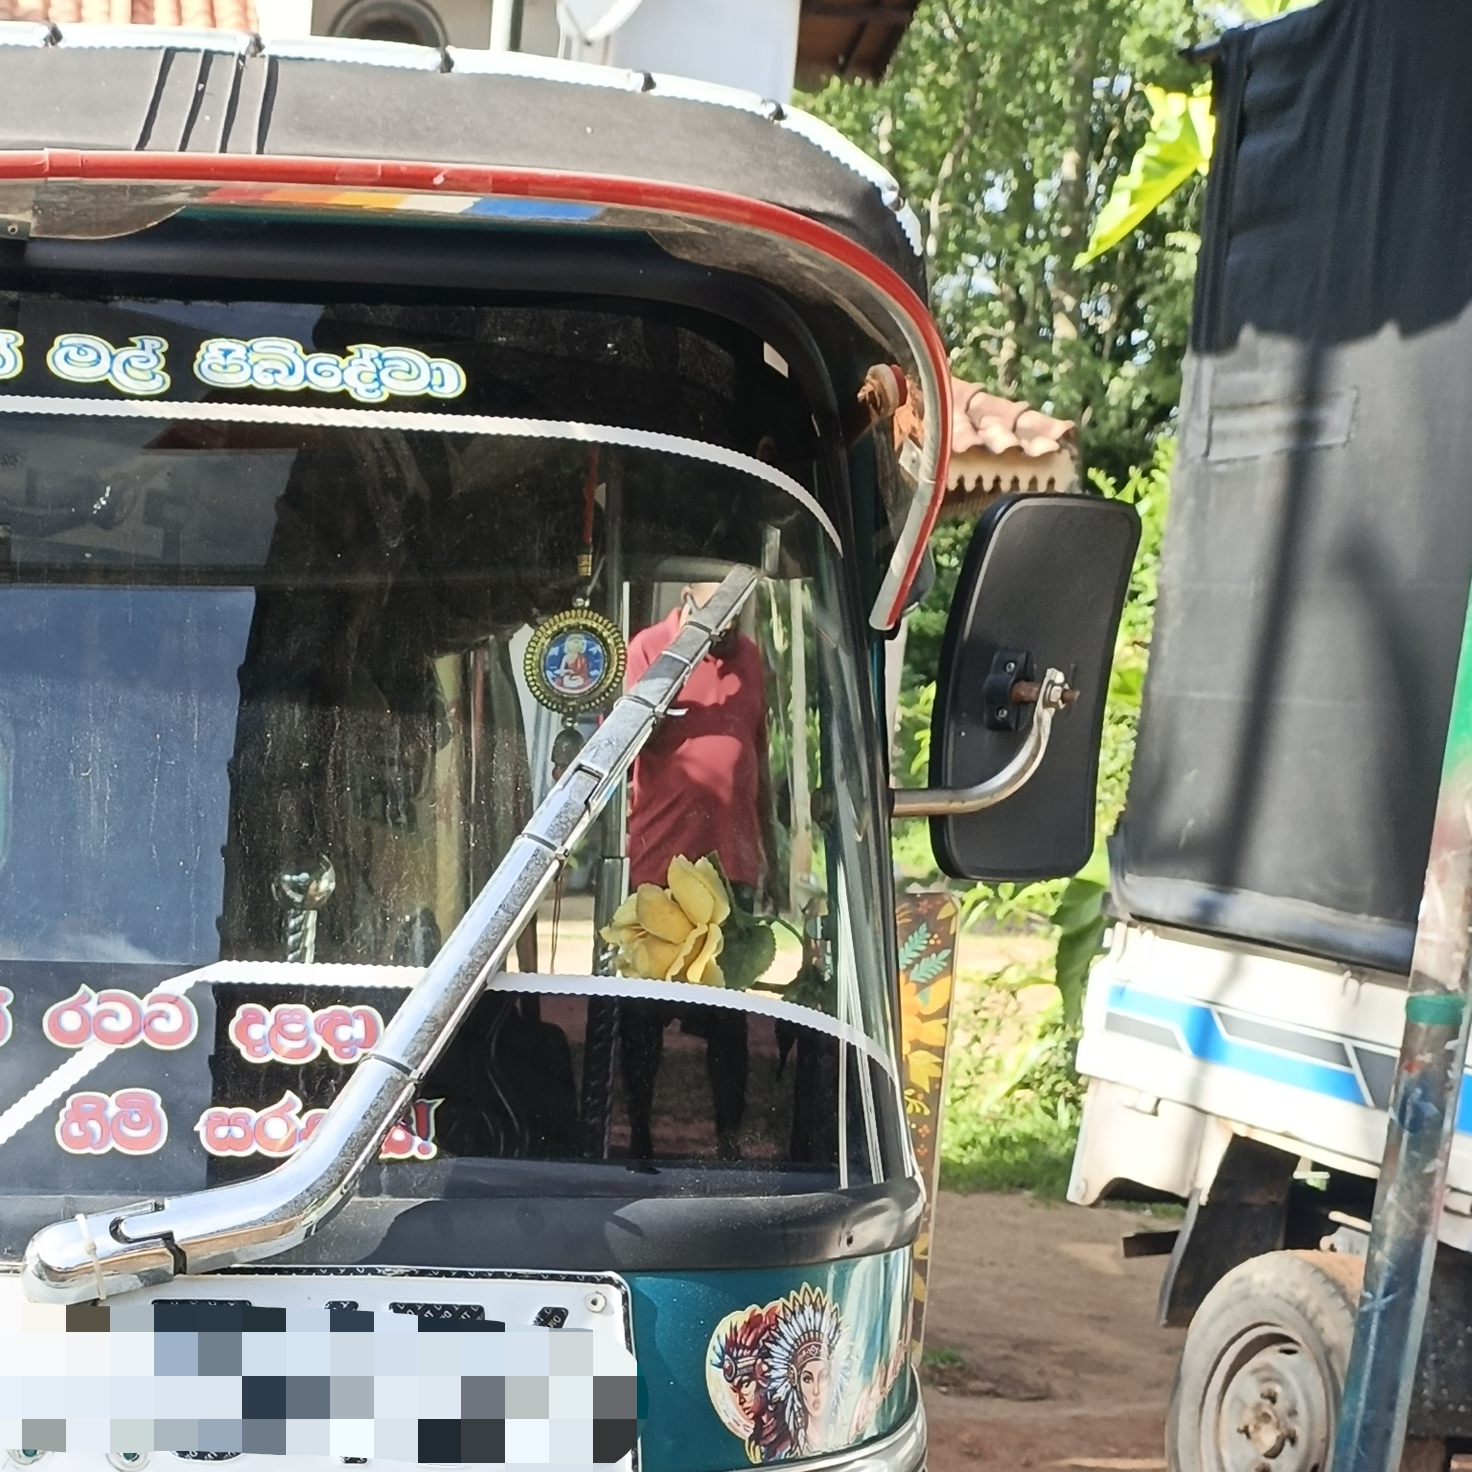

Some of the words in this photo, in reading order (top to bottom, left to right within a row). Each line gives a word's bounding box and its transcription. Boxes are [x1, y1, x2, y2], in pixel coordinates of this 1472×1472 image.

[46, 333, 171, 395] මල්
[42, 983, 198, 1050] රටට
[55, 1087, 168, 1156] හිමි
